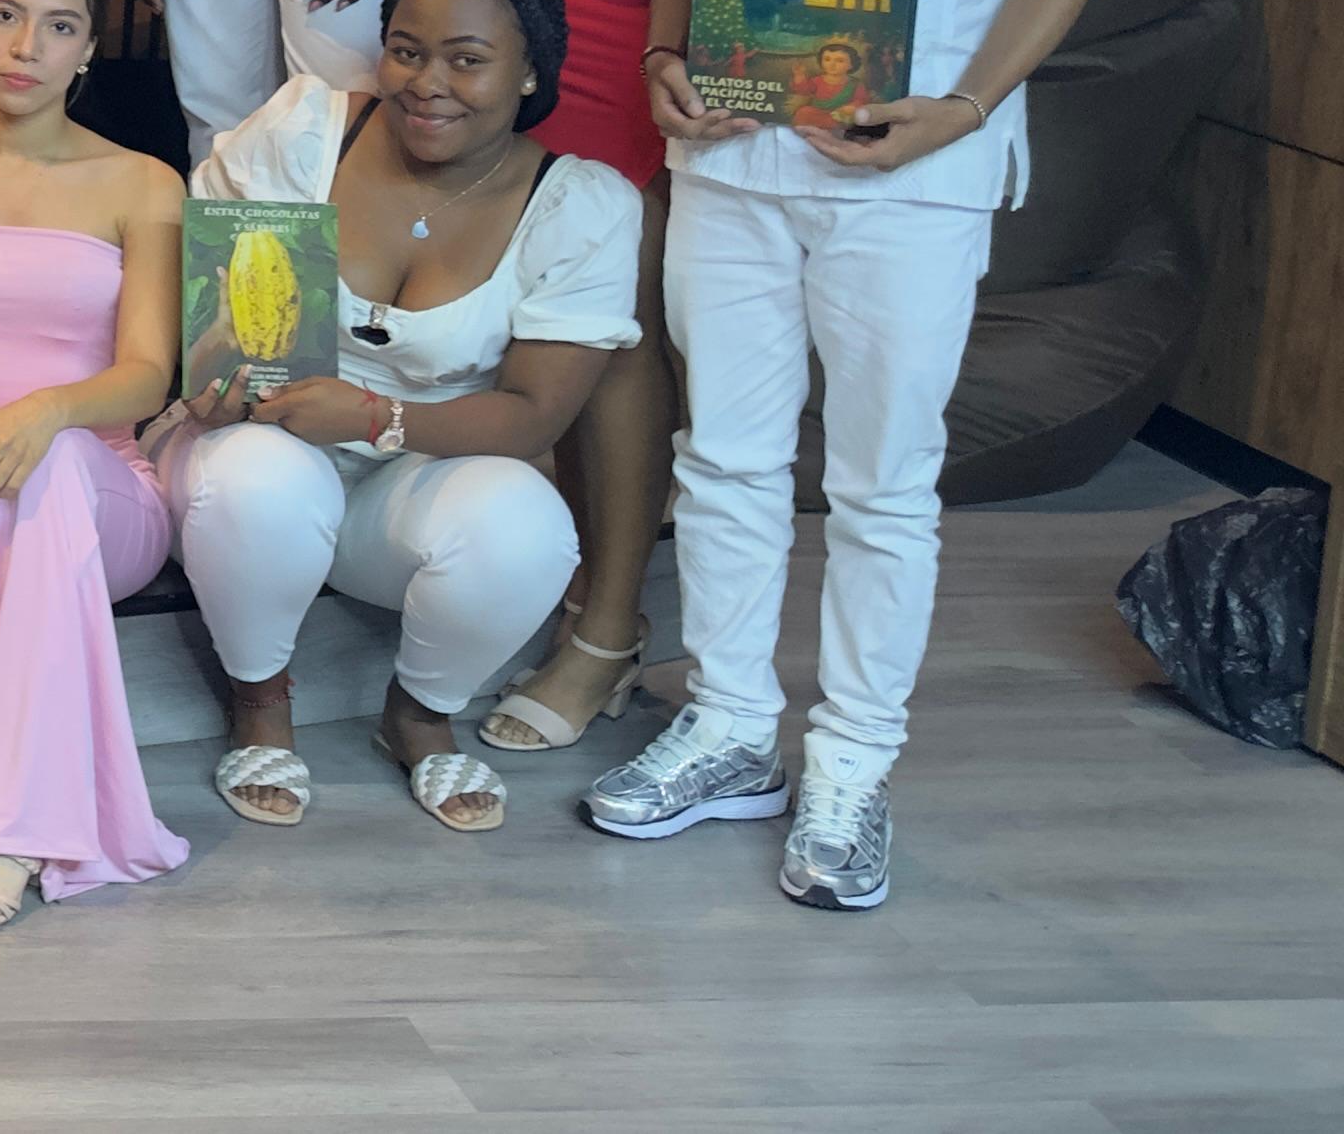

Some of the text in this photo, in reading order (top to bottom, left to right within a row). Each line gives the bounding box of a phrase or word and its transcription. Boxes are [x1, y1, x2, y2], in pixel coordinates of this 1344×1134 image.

[691, 74, 785, 93] RELATOS DEL
[726, 98, 775, 114] CAUCA
[203, 206, 244, 220] ENTRE
